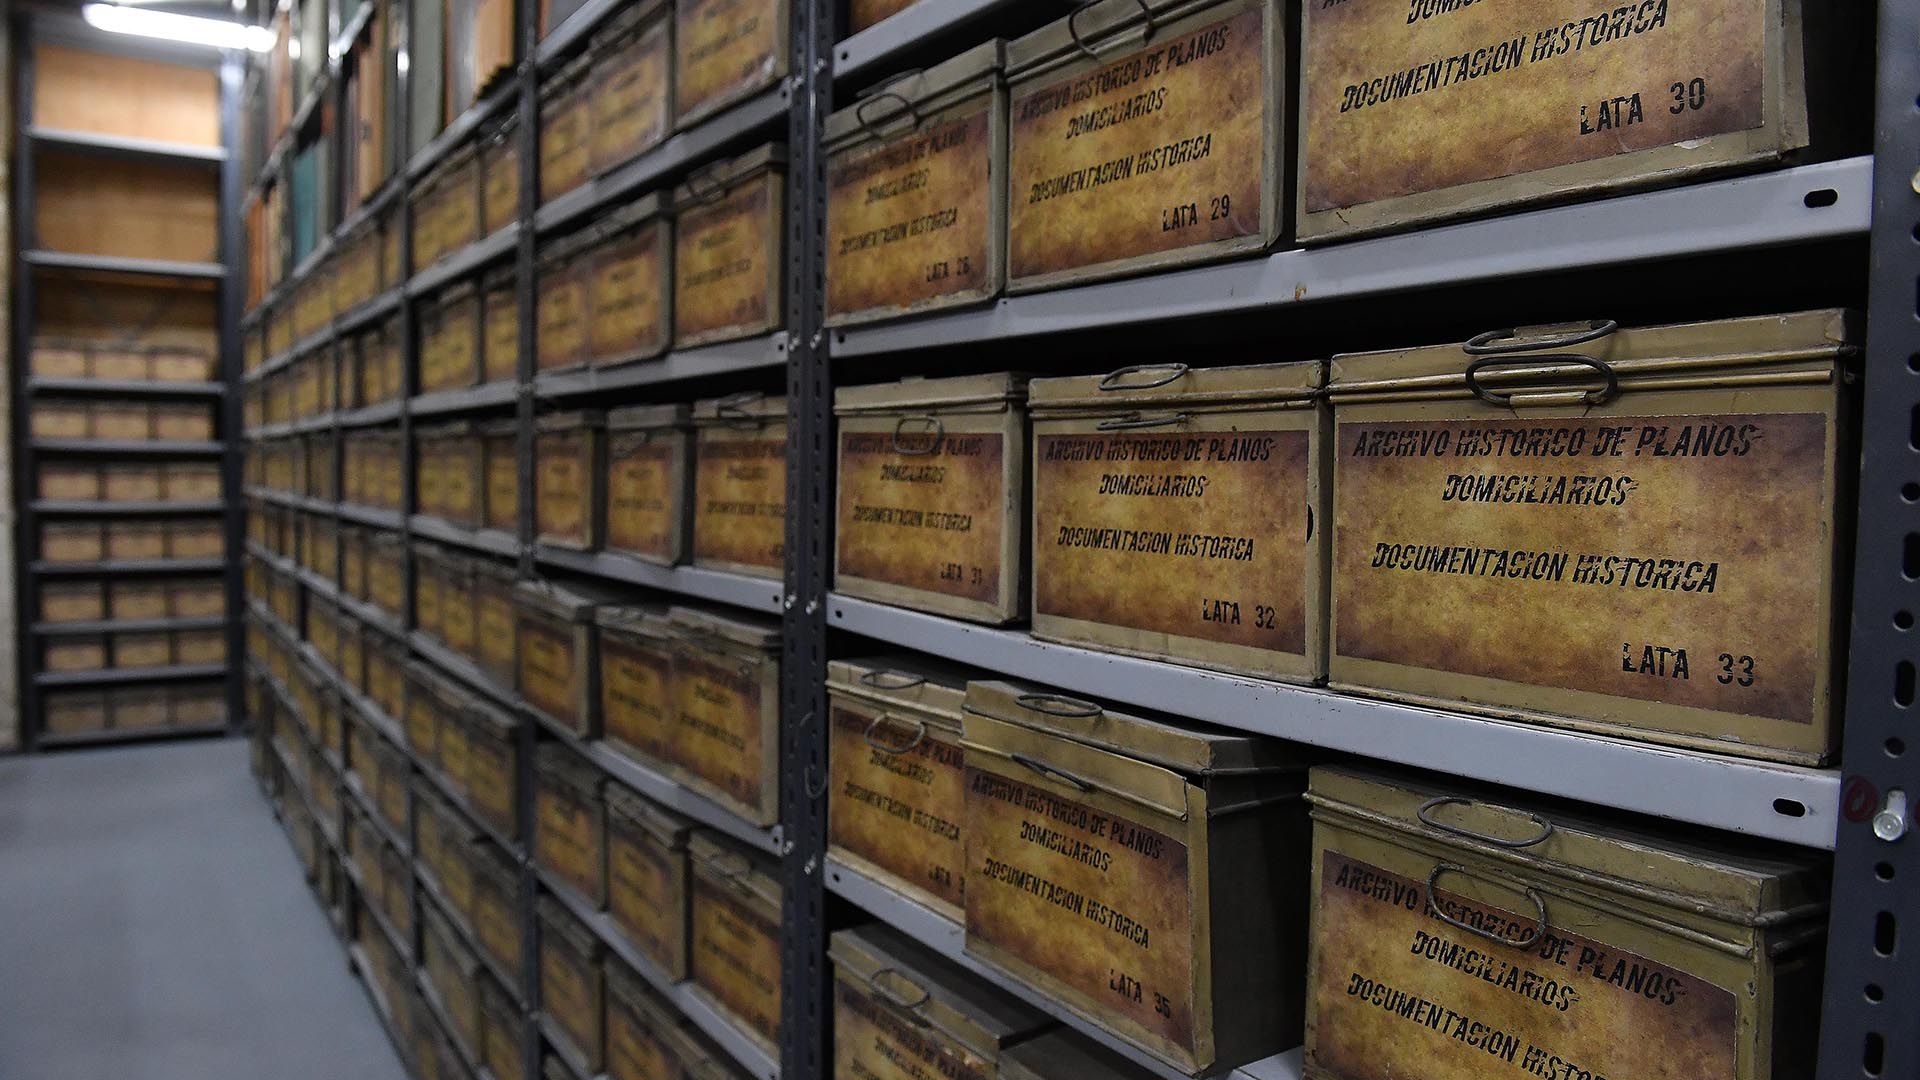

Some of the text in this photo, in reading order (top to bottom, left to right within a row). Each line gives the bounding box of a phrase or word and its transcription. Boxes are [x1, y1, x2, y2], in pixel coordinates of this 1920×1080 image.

[1143, 50, 1163, 79] DE
[1166, 25, 1229, 70] PLANOS
[1340, 0, 1668, 113] DOCUMENTACION HISTORICA
[1066, 87, 1167, 139] DOMICILIARIOS
[1580, 78, 1706, 135] LATA 30
[1029, 133, 1212, 204] DOCUMENTACION HISTORICA
[1162, 194, 1230, 232] LATA 29
[1046, 437, 1277, 462] ARCHIVO HISTORICO DE PLANOS
[1352, 424, 1761, 458] ARCHIVO HISTORICO DE PLANOS
[1099, 474, 1209, 497] DOMICILIARIOS
[1442, 474, 1637, 506] DOMICILIARIOS
[1057, 526, 1254, 562] DOCUMENTACION HISTORICA
[1371, 542, 1720, 594] DOCUMENTACION HISTORICA
[1202, 598, 1276, 630] LATA 32
[1622, 642, 1756, 687] LATA 33
[1020, 820, 1112, 872] DOMICILIARIOS
[1090, 814, 1108, 837] DE
[1109, 821, 1162, 860] PLANOS
[983, 857, 1149, 949] DOCUMENTACION HISTORICA
[1335, 863, 1418, 912] ARCHIVO
[1540, 932, 1570, 968] DE
[1578, 946, 1683, 1006] PLANOS
[1109, 969, 1142, 1004] LATA
[1411, 930, 1577, 1012] DOMICILIARIOS
[1347, 973, 1520, 1062] DOCUMENTACION
